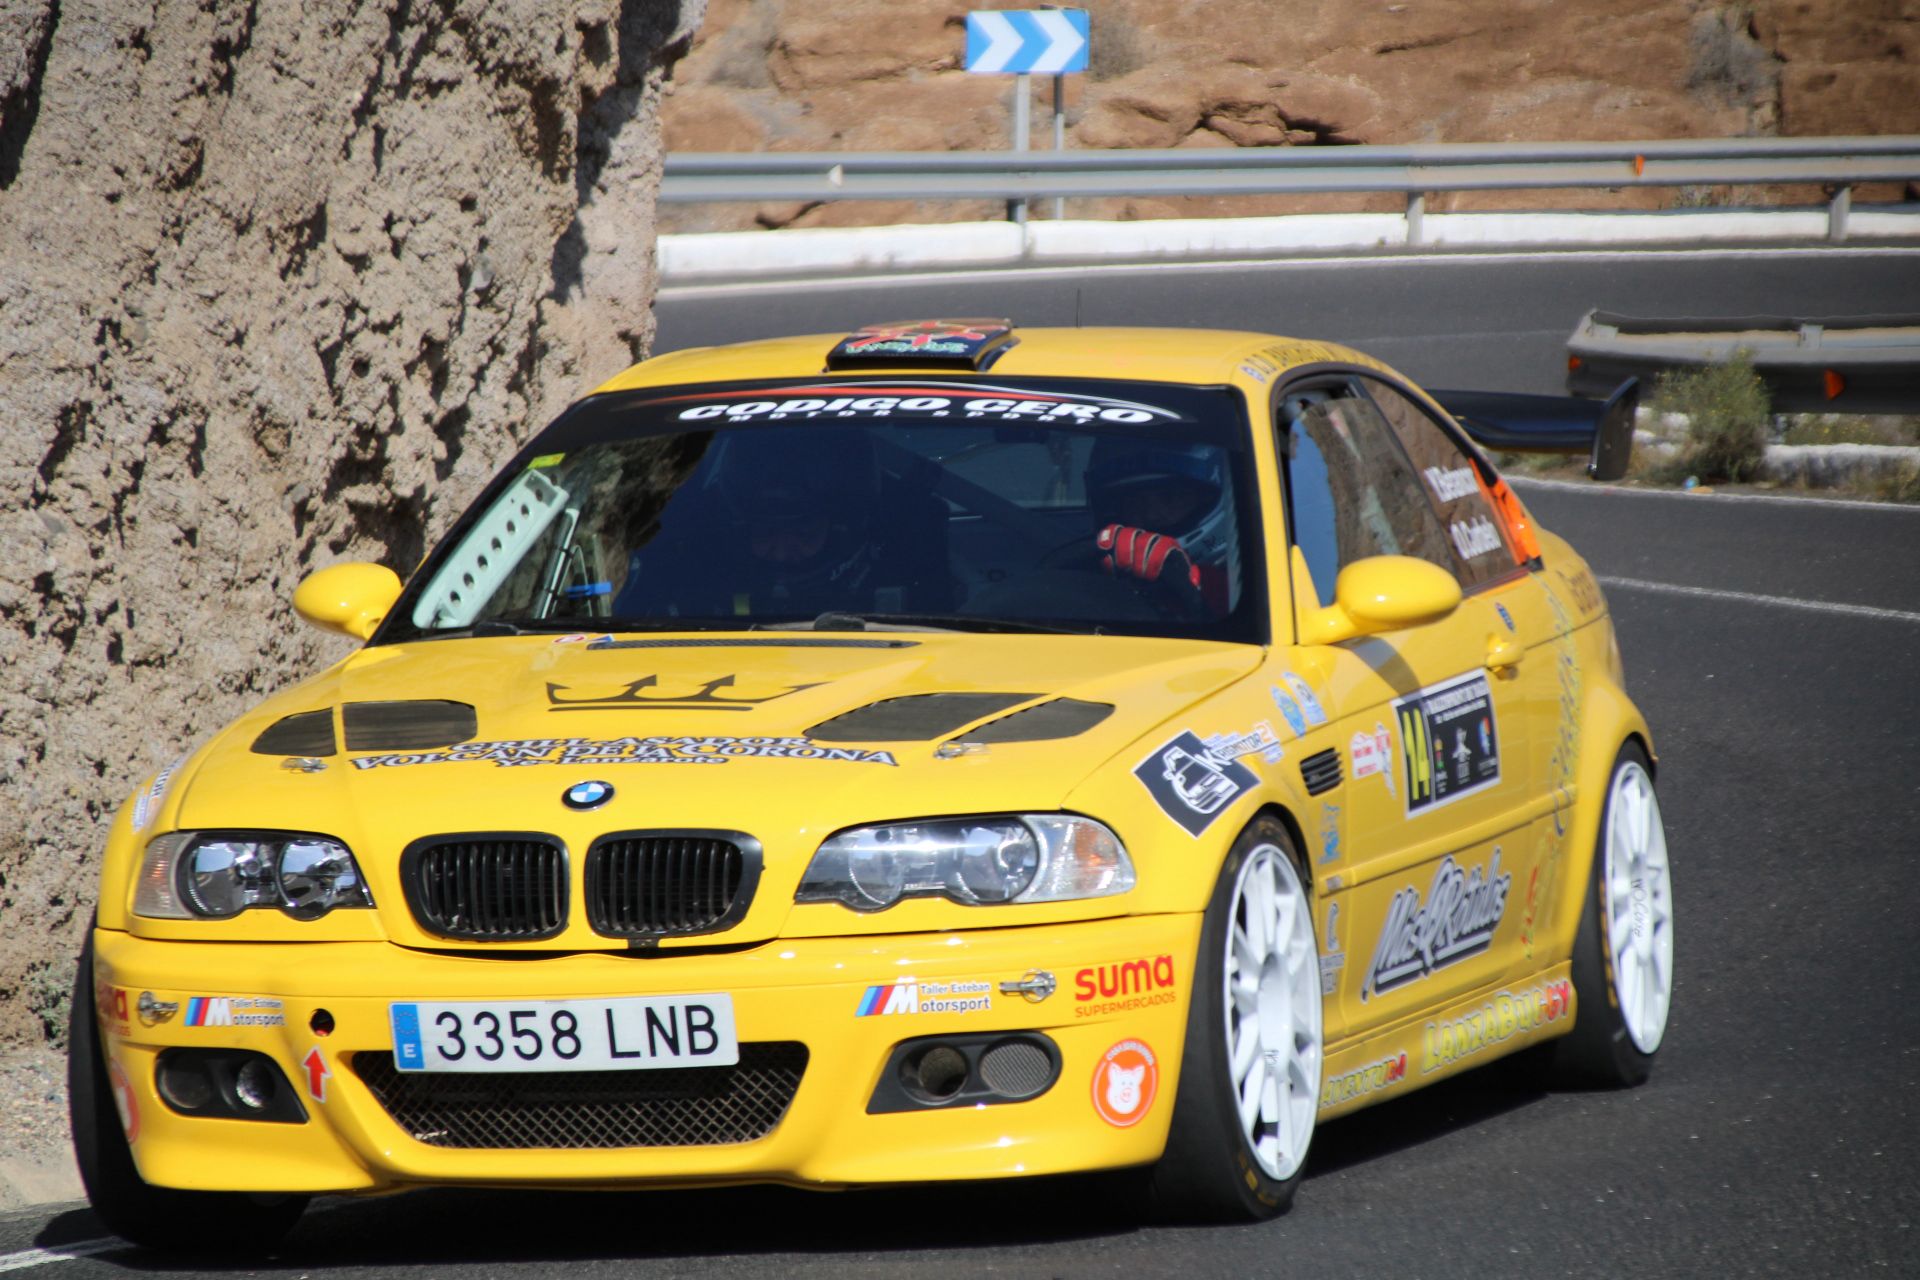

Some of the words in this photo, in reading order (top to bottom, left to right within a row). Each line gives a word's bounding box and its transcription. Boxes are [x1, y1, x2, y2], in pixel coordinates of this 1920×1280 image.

[678, 397, 951, 421] CODIGO
[963, 399, 1154, 424] CERO
[678, 743, 899, 767] CORONA
[921, 984, 948, 995] Taller
[950, 982, 991, 994] Esteban
[1074, 954, 1175, 1002] suma
[1074, 990, 1177, 1019] SUPERMERCADOS
[434, 1009, 582, 1062] 3358
[605, 1004, 719, 1060] LNB
[402, 1043, 417, 1058] E
